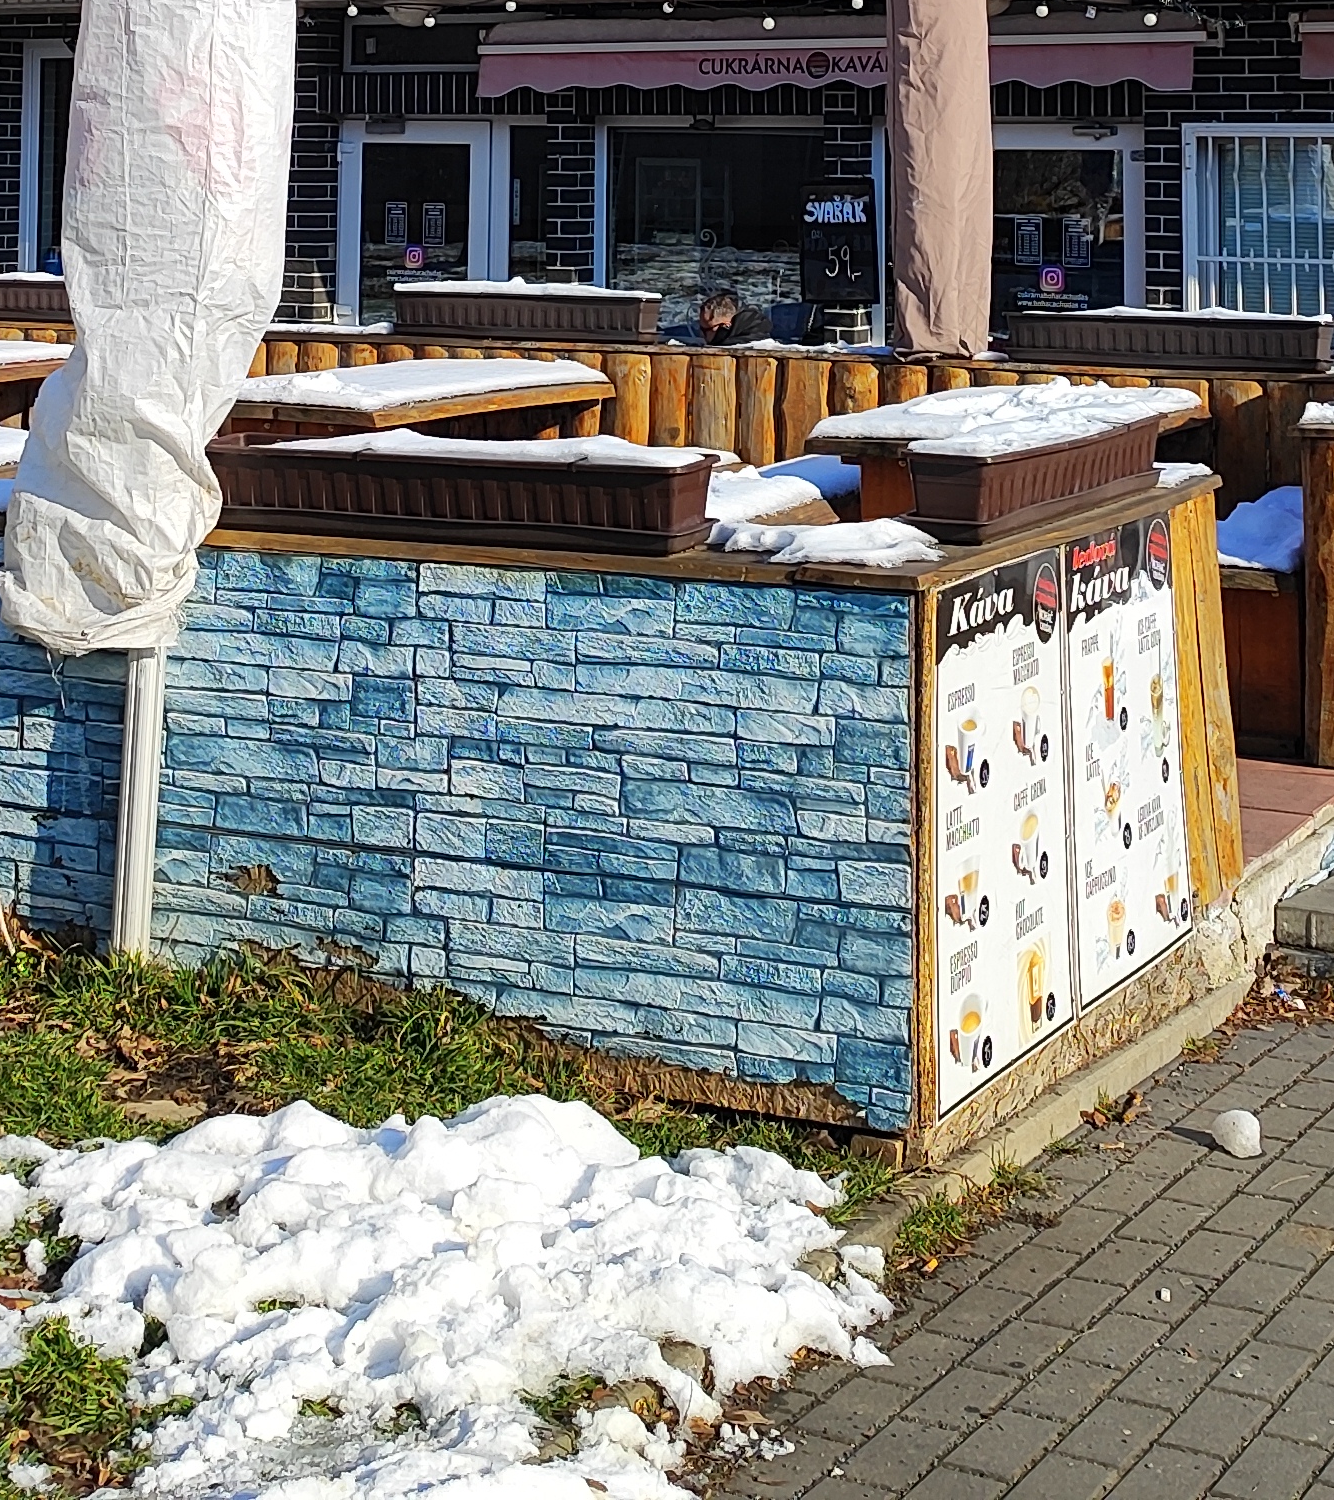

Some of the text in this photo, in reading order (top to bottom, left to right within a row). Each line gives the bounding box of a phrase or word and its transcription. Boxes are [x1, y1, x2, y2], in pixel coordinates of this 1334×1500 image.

[698, 51, 888, 75] CUKRÁRNA KAVÁ
[1070, 566, 1130, 613] káva
[947, 587, 1014, 637] Káva
[947, 683, 976, 713] ESPRESSO
[946, 805, 963, 830] LATTE
[946, 817, 980, 852] MACCHIATO
